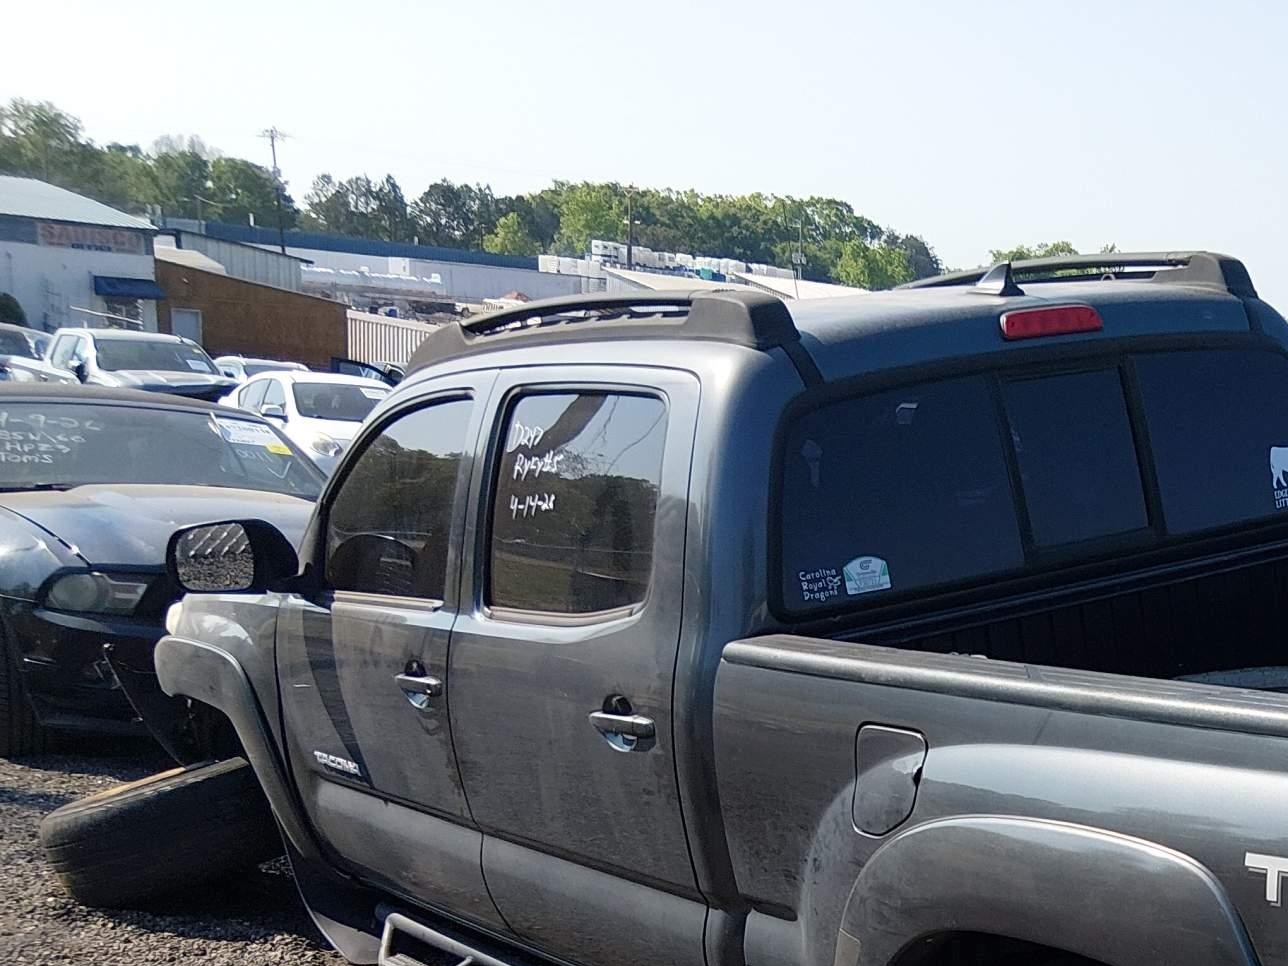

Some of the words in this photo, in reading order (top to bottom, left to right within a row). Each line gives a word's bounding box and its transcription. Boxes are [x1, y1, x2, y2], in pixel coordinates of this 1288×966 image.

[799, 568, 837, 581] Carolina
[801, 580, 828, 592] Royal
[803, 588, 838, 602] Dragons
